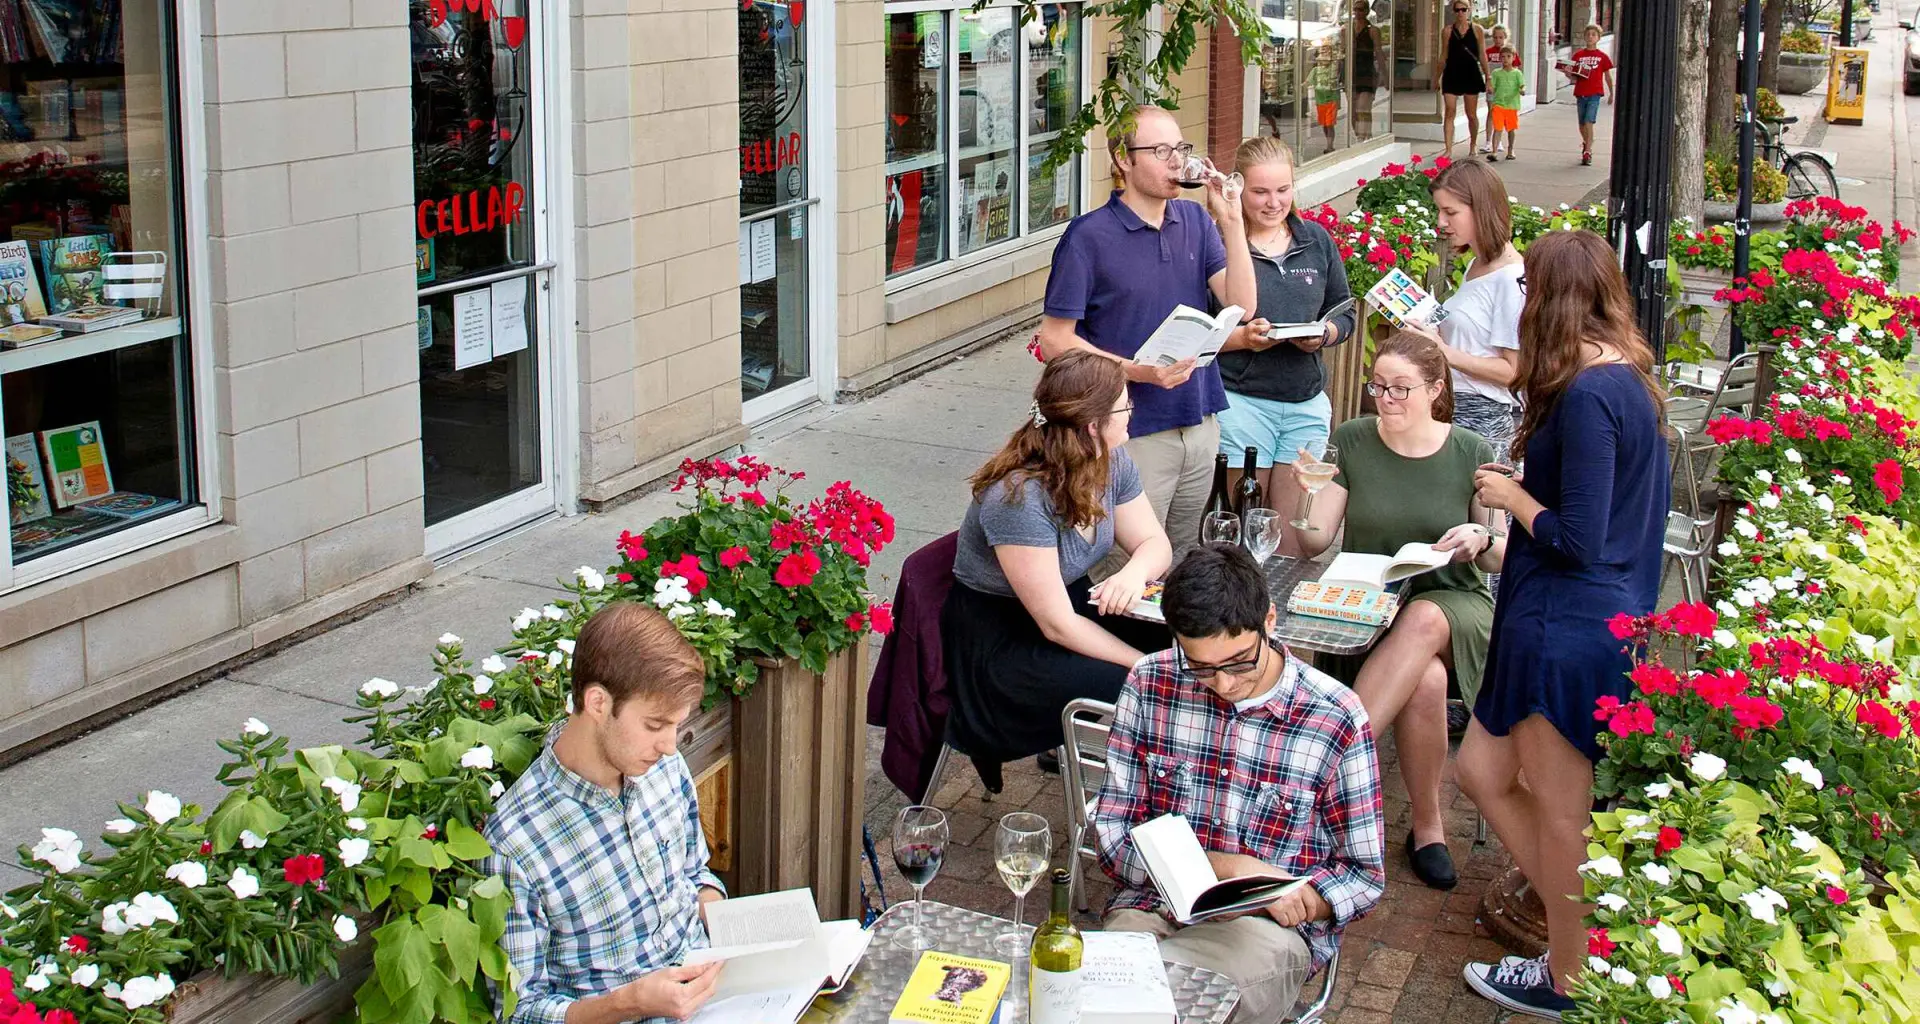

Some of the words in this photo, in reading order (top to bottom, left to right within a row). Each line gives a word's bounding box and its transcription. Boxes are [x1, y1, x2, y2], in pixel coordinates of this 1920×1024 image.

[430, 0, 499, 28] BK
[738, 131, 801, 176] ELLAR
[417, 182, 525, 239] CELLAR
[989, 208, 1009, 226] GIRL
[0, 245, 26, 258] Birdy
[68, 238, 96, 252] Little
[1375, 273, 1411, 301] THE
[933, 1008, 980, 1019] meeting
